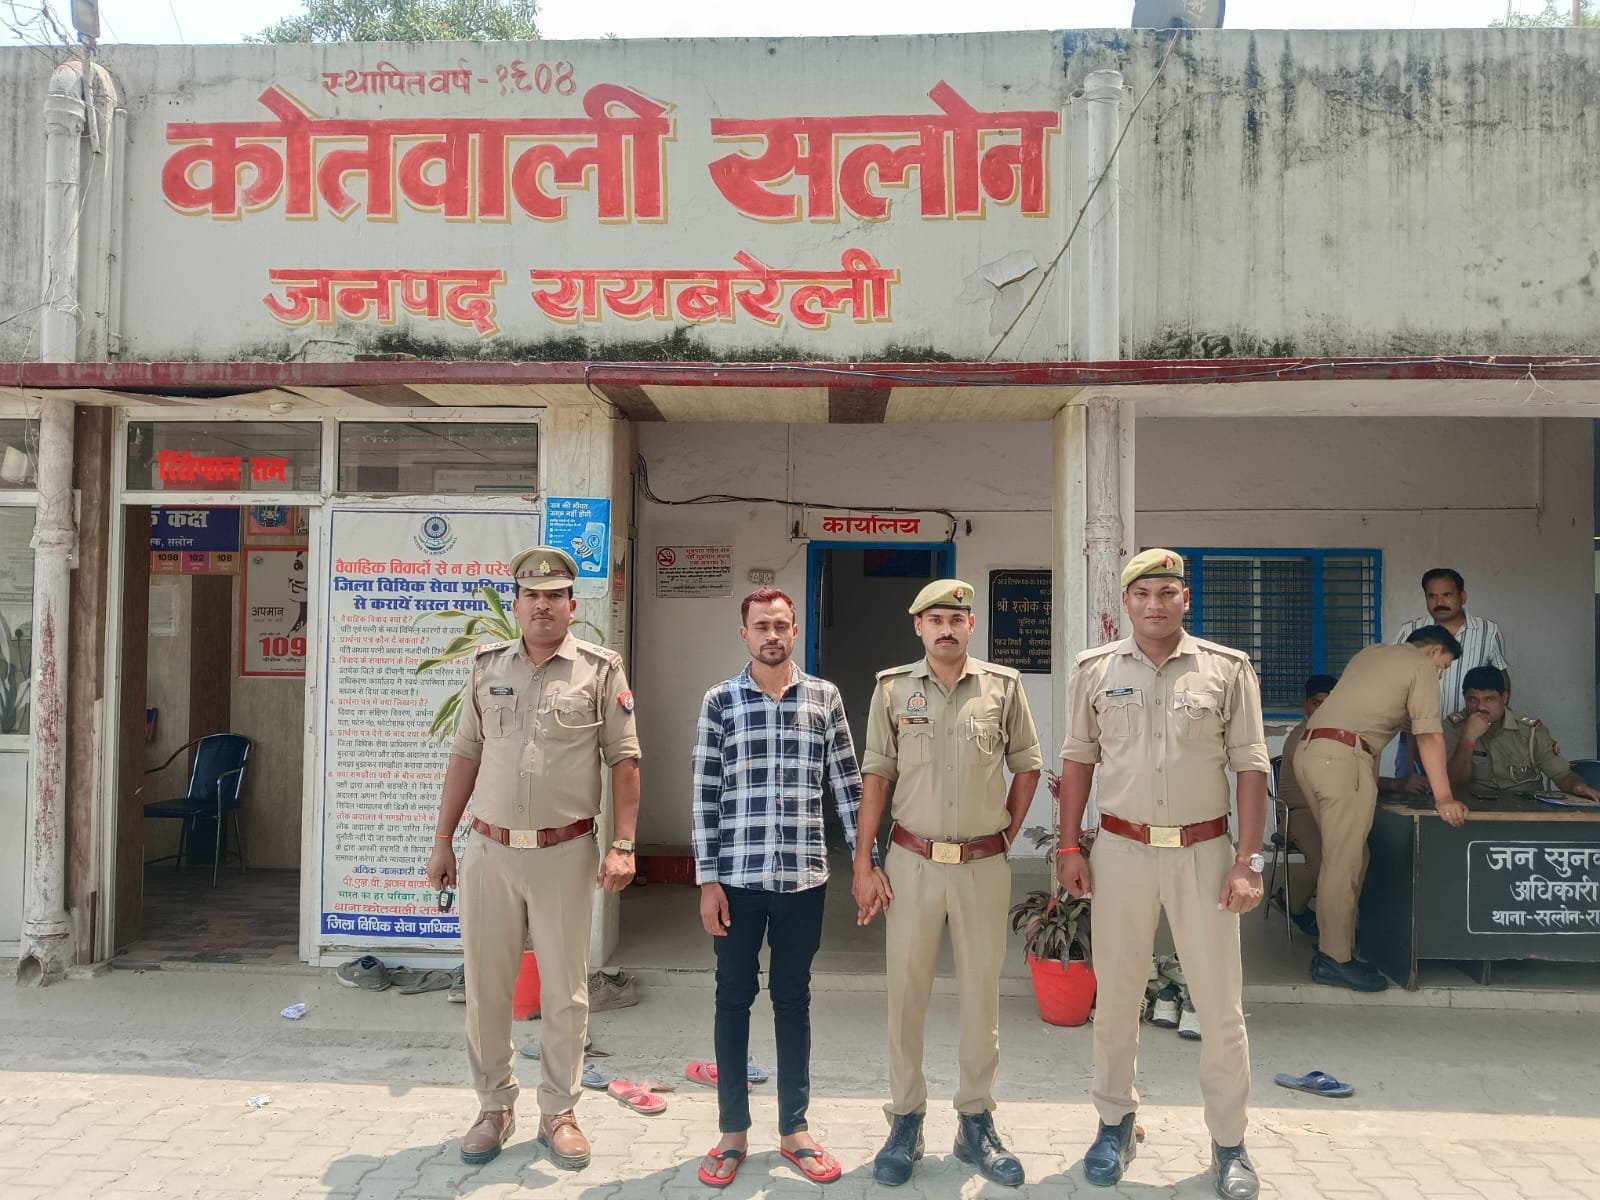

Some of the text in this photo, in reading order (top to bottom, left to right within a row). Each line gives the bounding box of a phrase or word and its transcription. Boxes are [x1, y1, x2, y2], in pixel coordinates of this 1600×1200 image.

[162, 80, 1061, 224] कोतवाली सलोन
[263, 247, 900, 339] जनपद रायबरेली
[166, 511, 210, 528] कक्ष
[822, 514, 921, 535] कार्यालय
[168, 536, 194, 546] सलोन
[217, 554, 232, 562] 108
[335, 559, 385, 574] वैवाहिक
[390, 559, 430, 575] विवादों
[435, 561, 447, 575] से
[451, 564, 461, 574] न
[466, 561, 481, 575] हो
[334, 577, 373, 592] जिला
[377, 578, 426, 593] विधिक
[430, 579, 458, 593] सेवा
[251, 607, 284, 616] अपमान
[353, 596, 367, 609] से
[370, 596, 412, 610] करायें
[415, 600, 449, 611] सरल
[997, 598, 1009, 613] श्री
[1012, 597, 1039, 613] श्लोक
[1486, 847, 1538, 870] जन
[353, 865, 376, 873] अधिक
[380, 866, 415, 875] जानकारी
[374, 891, 383, 899] हर
[423, 891, 431, 901] हो
[1510, 875, 1600, 902] अधिकारी
[335, 903, 359, 911] थाना
[362, 903, 416, 913] कोतवाली
[327, 915, 354, 930] जिला
[358, 916, 392, 931] विधिक
[394, 919, 416, 932] सेवा
